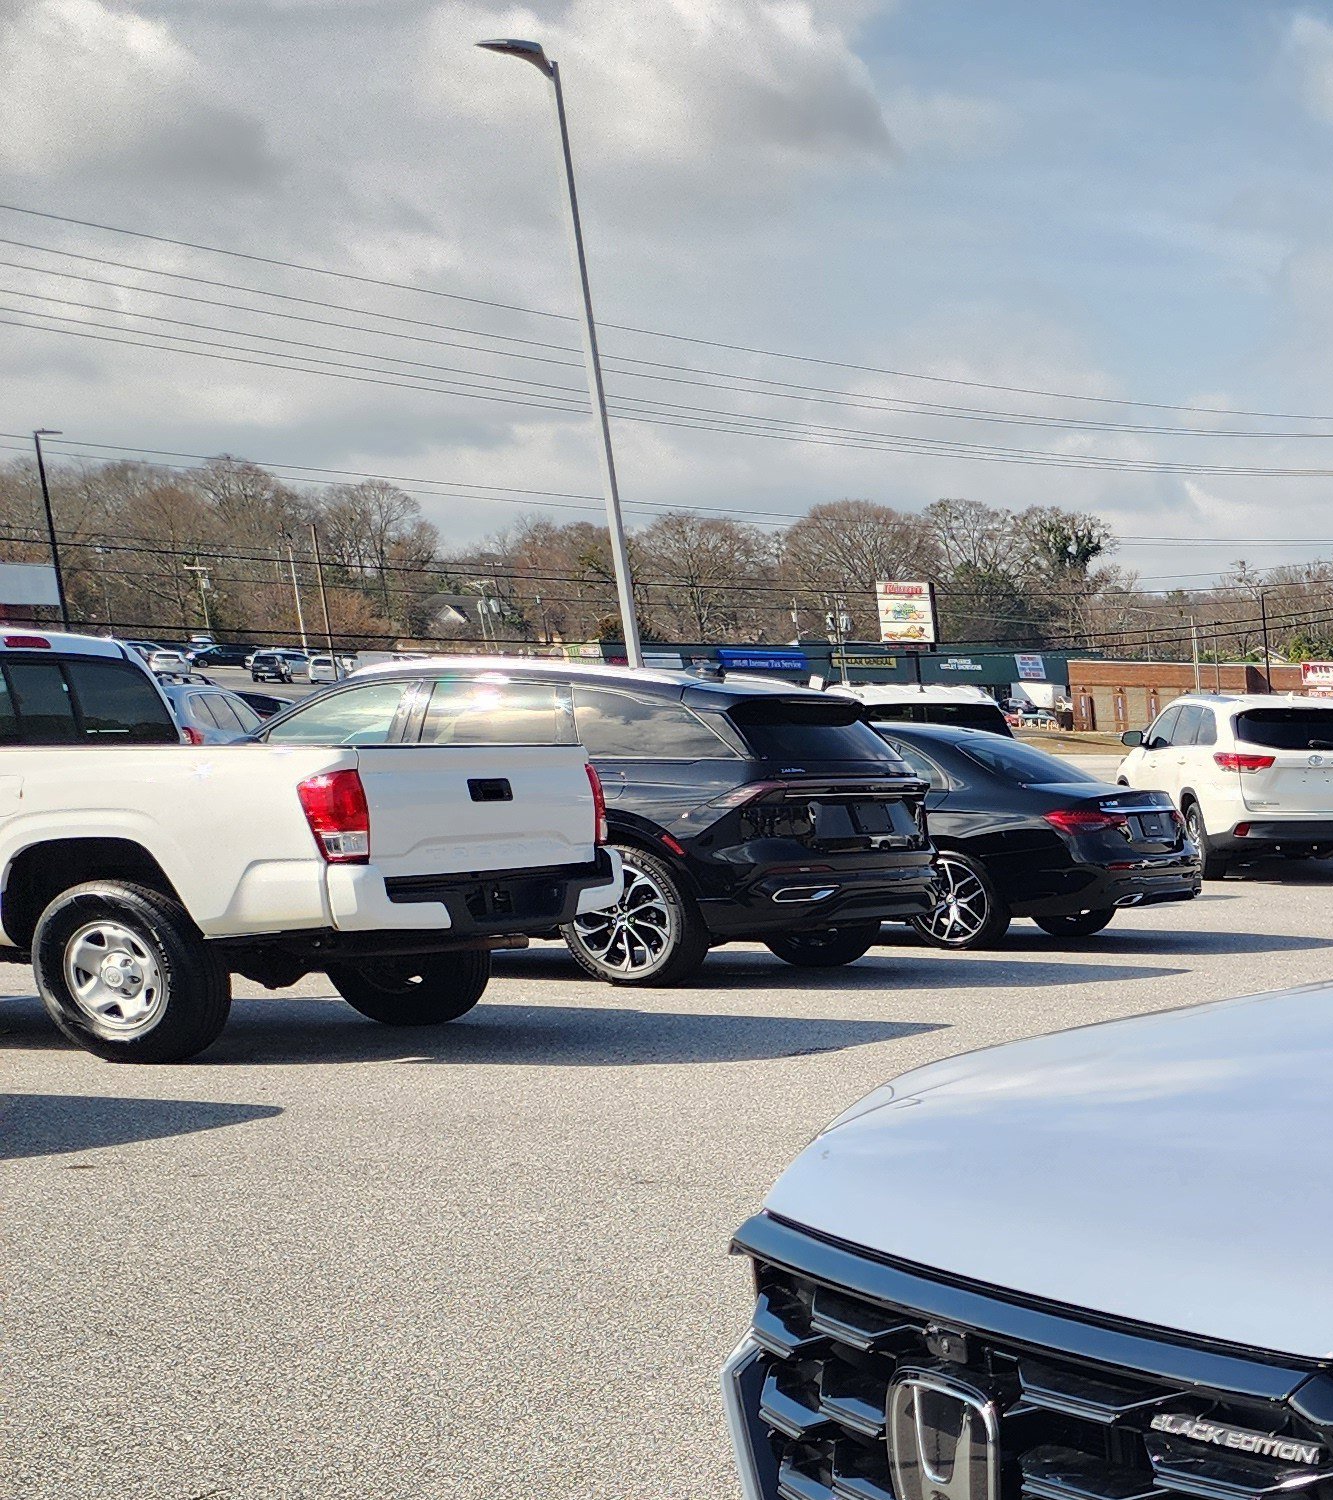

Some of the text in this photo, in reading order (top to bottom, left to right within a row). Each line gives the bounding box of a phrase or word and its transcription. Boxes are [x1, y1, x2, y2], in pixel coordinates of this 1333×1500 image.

[769, 660, 781, 668] Tax
[781, 660, 802, 669] Service
[642, 864, 677, 905] MICHELIN
[1150, 1413, 1320, 1466] BLACK EDITION
